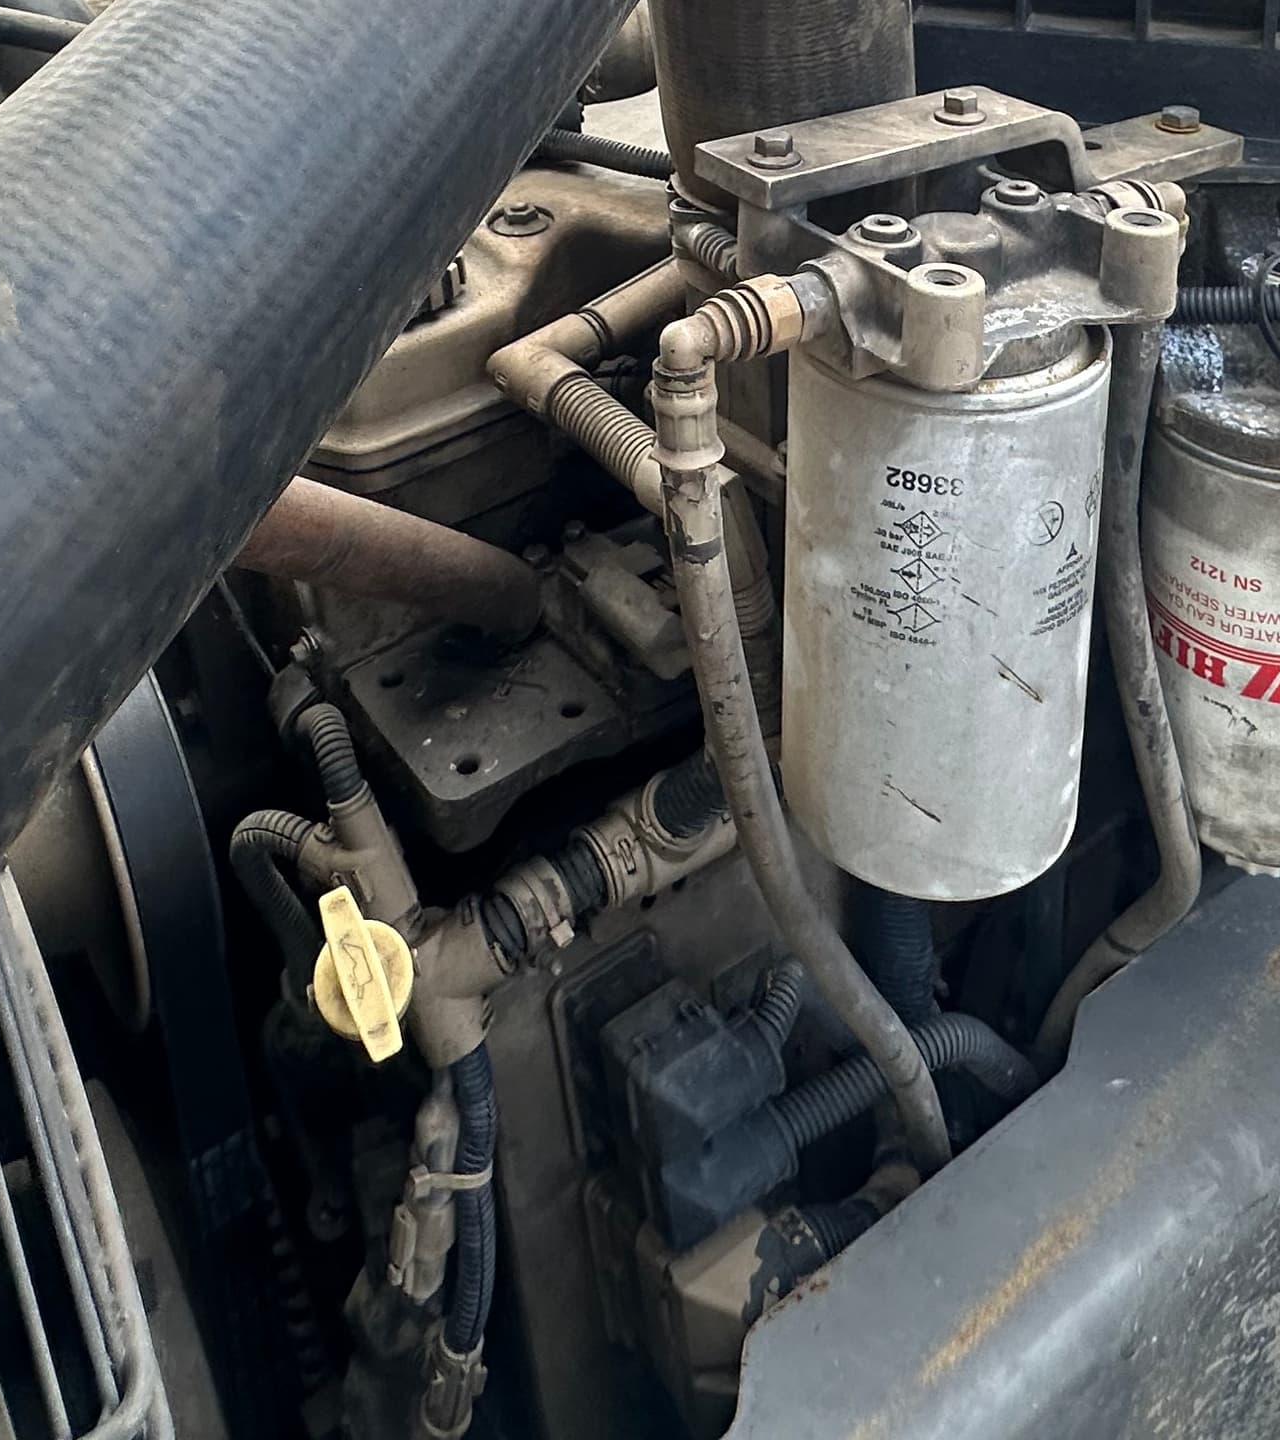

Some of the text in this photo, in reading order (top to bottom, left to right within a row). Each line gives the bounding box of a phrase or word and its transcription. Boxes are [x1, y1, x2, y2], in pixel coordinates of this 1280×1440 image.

[886, 465, 964, 497] 33682
[1190, 555, 1263, 593] SN 1212
[1186, 604, 1216, 628] EAU
